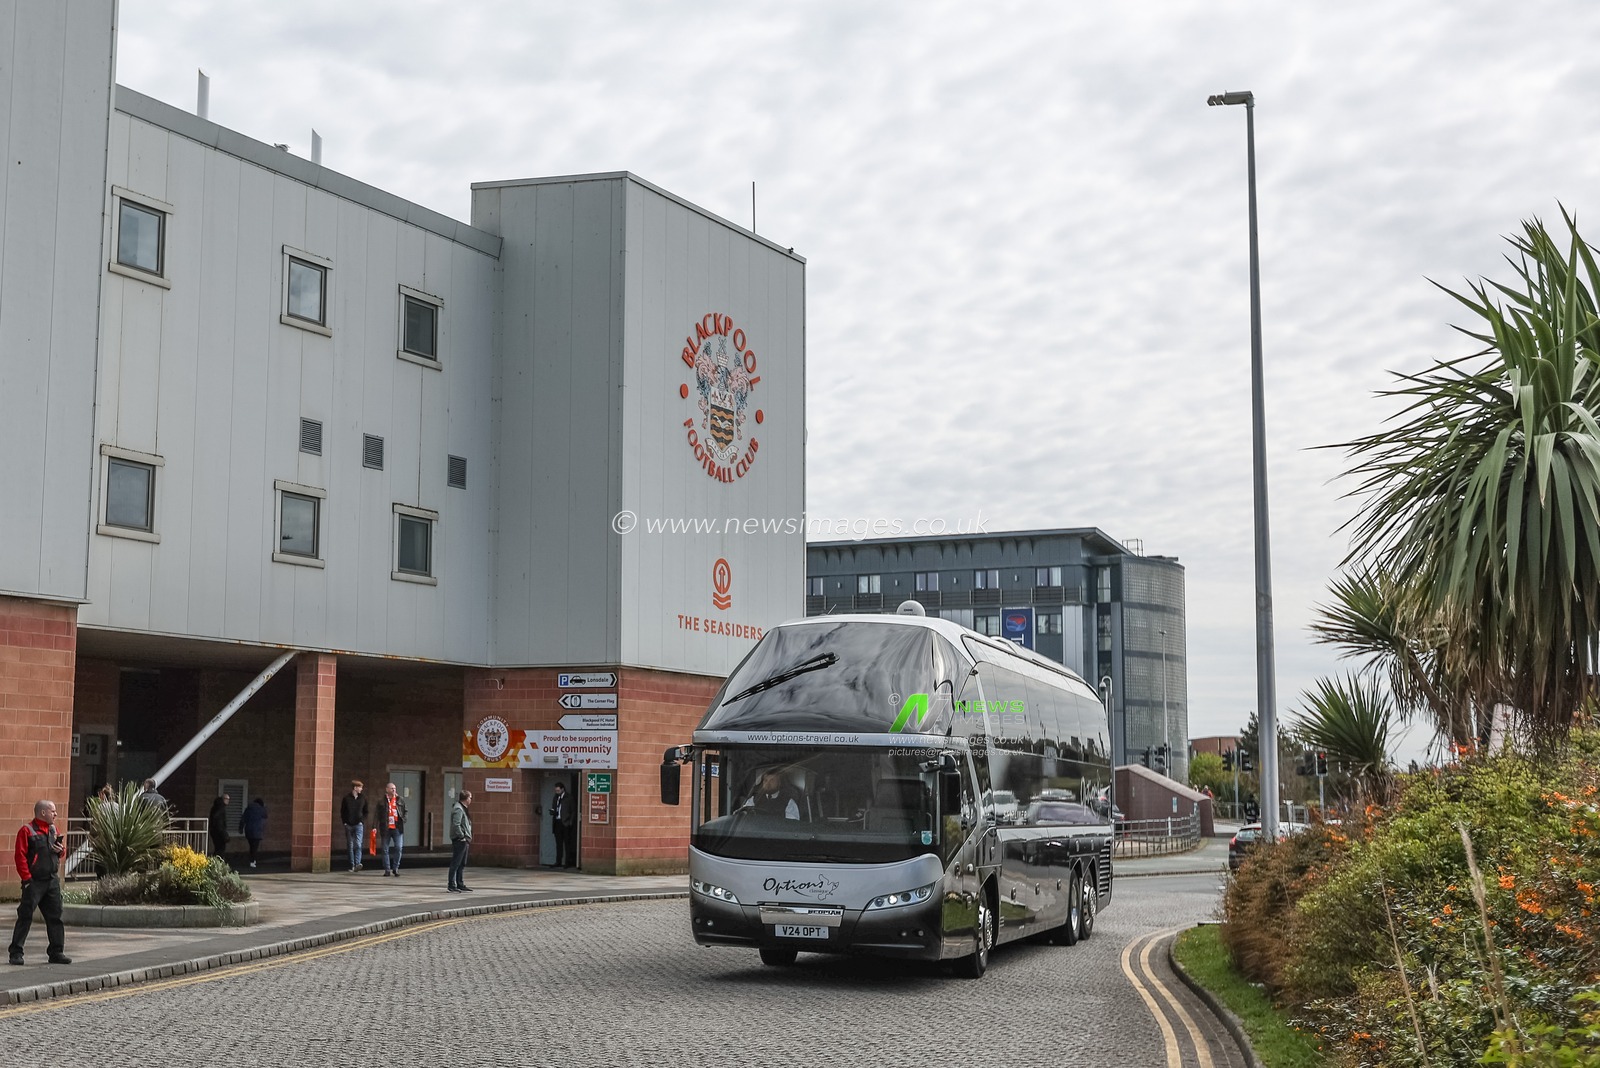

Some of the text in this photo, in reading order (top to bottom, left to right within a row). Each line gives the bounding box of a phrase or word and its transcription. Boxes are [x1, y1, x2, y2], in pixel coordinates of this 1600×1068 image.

[681, 312, 761, 391] BLACKPOOL
[683, 417, 735, 483] FOOTBALL
[736, 437, 759, 478] CLUB
[678, 614, 763, 641] THE SEASIDERS
[477, 715, 509, 729] COMMUNITY
[480, 721, 506, 735] BLACKPOOL
[578, 735, 612, 743] supporting
[86, 742, 98, 755] 12
[543, 743, 612, 756] our community
[763, 877, 824, 896] Options
[782, 926, 821, 937] V24 OPT
